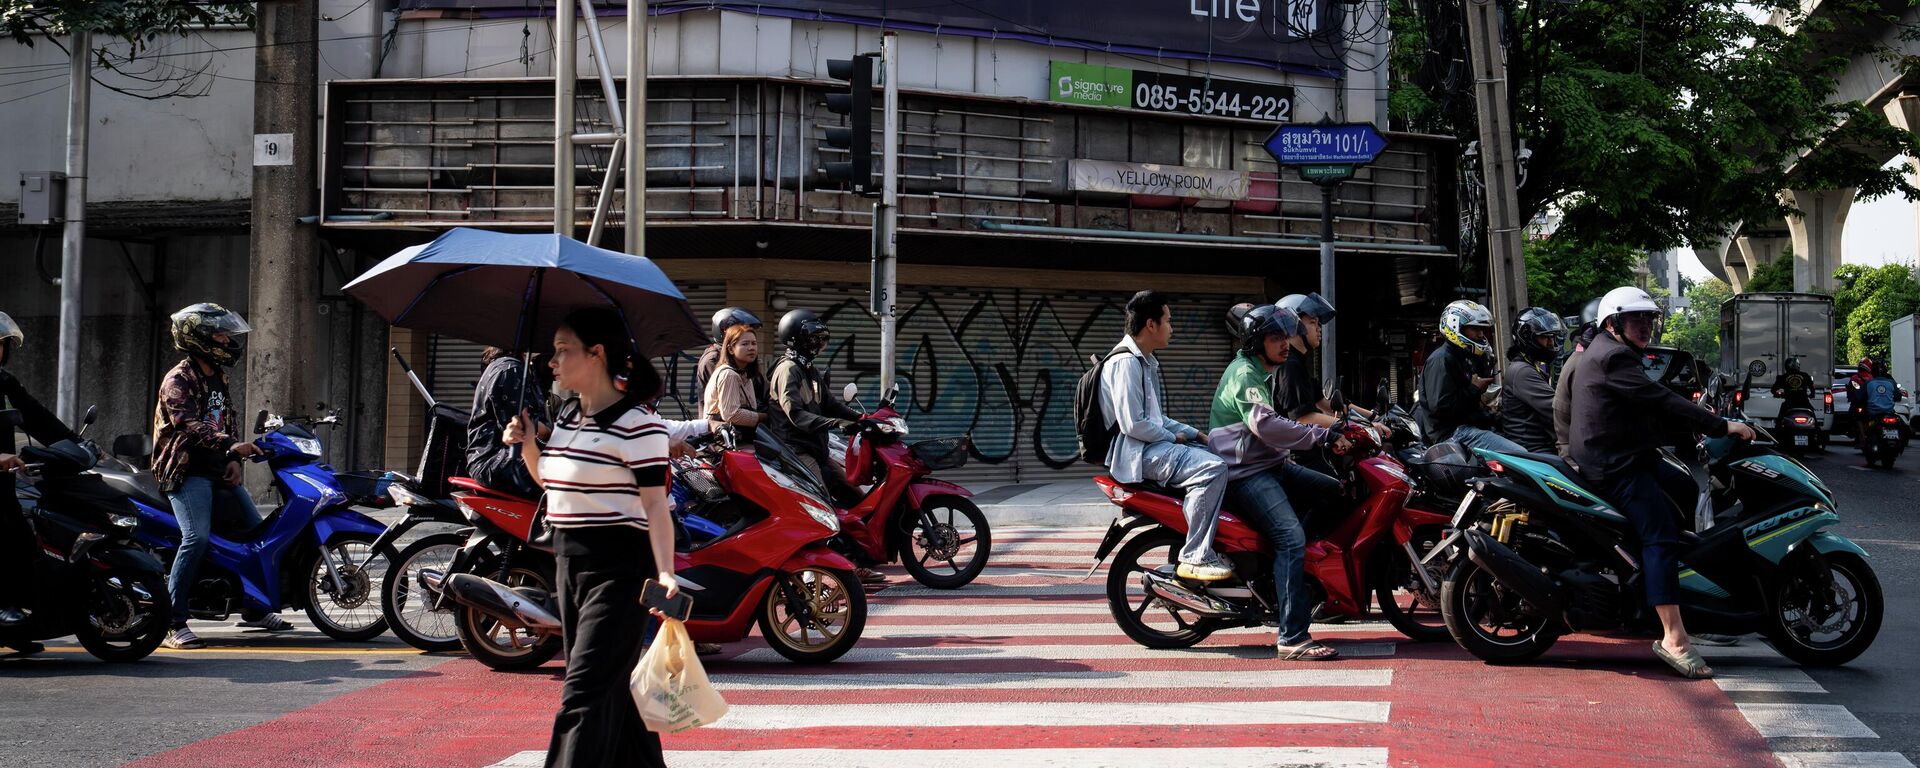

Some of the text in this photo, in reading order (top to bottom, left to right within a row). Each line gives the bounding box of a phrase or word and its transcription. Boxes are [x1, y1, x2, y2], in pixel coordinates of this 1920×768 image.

[1073, 91, 1102, 101] media
[1135, 82, 1290, 121] 085-5544-222
[1282, 129, 1369, 153] สุขุมวิท 101/1
[1116, 169, 1213, 190] YELLOW ROOM
[1739, 460, 1781, 479] 155
